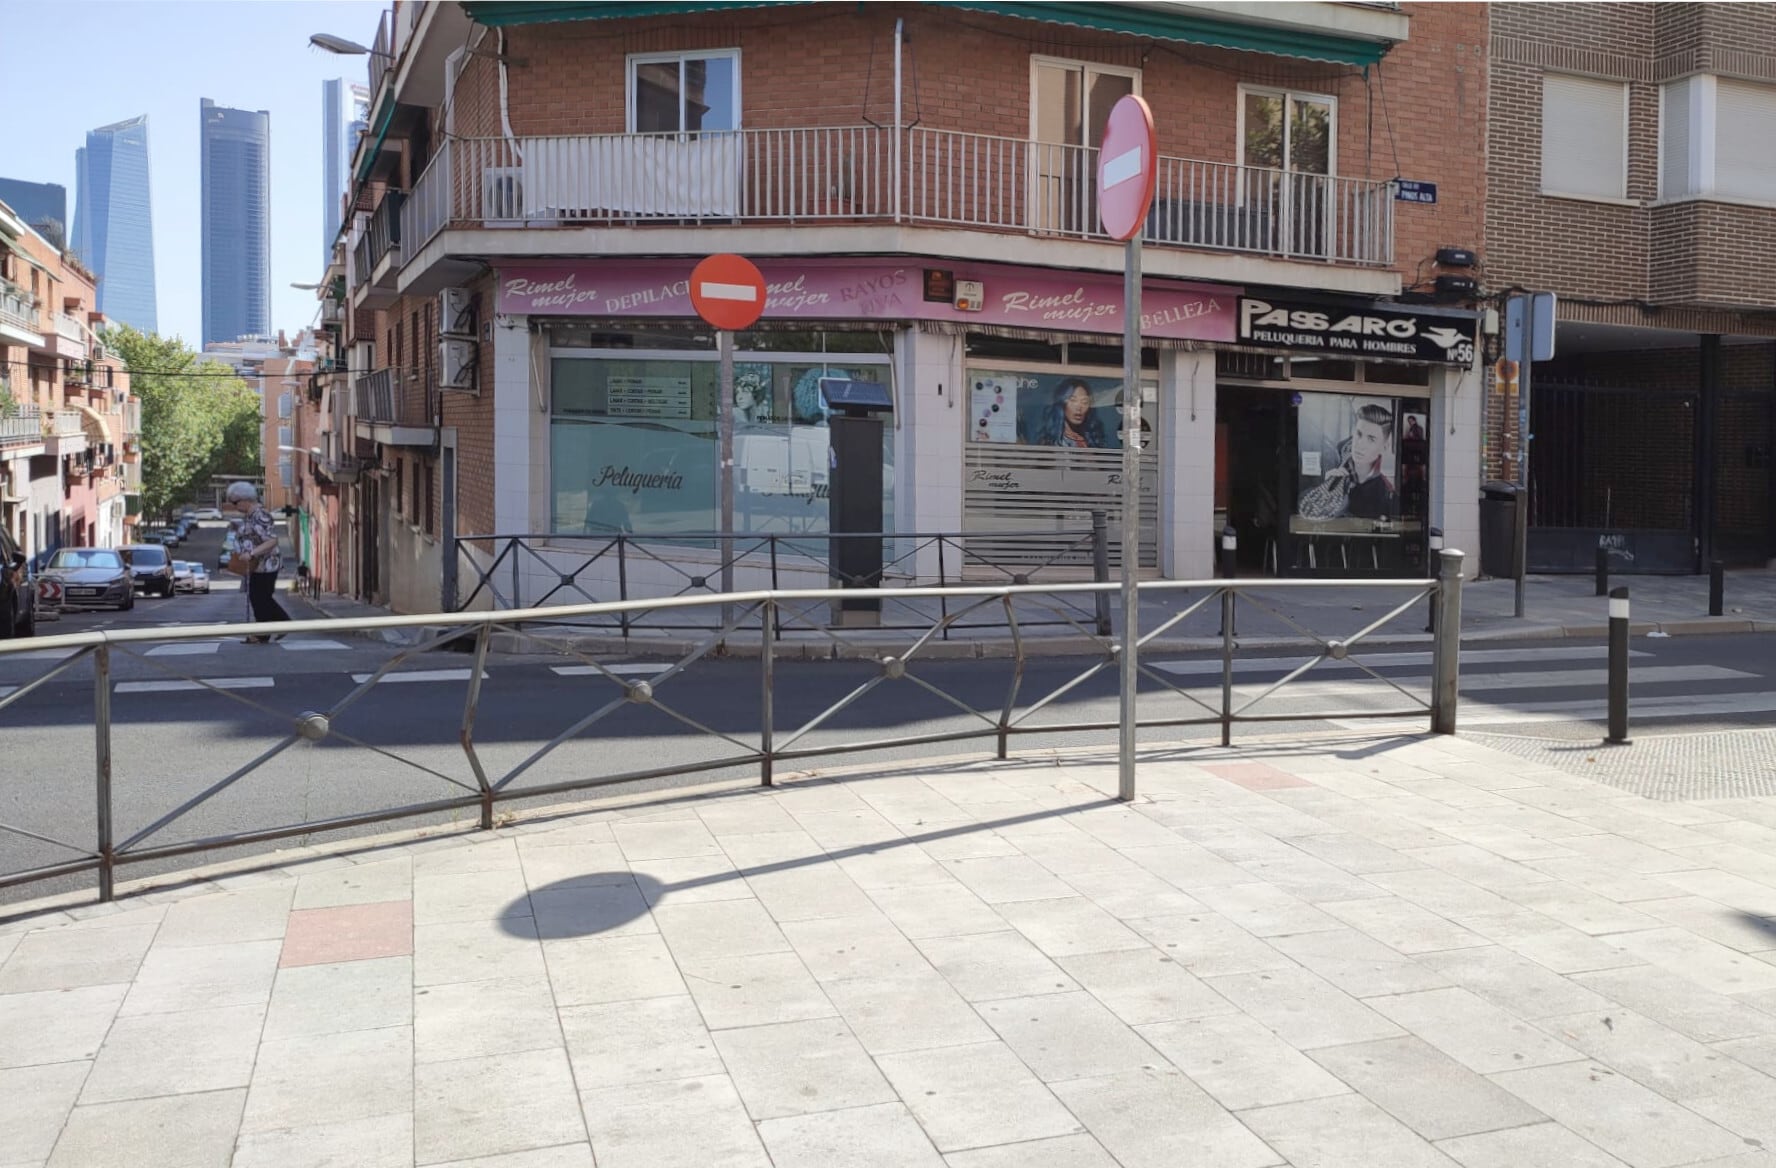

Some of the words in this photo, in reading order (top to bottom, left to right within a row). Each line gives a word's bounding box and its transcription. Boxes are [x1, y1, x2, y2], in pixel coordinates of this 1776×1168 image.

[505, 273, 576, 298] Rimel
[531, 287, 598, 309] mujer
[605, 279, 690, 313] DEPILACI
[840, 269, 908, 302] RAYOS
[1002, 287, 1085, 313] Rimel
[1043, 300, 1117, 323] mujer
[1140, 298, 1222, 330] BELLEZA
[1253, 330, 1324, 347] PELUQUERIA
[1330, 337, 1358, 349] PARA
[1363, 340, 1417, 354] HOMBRES
